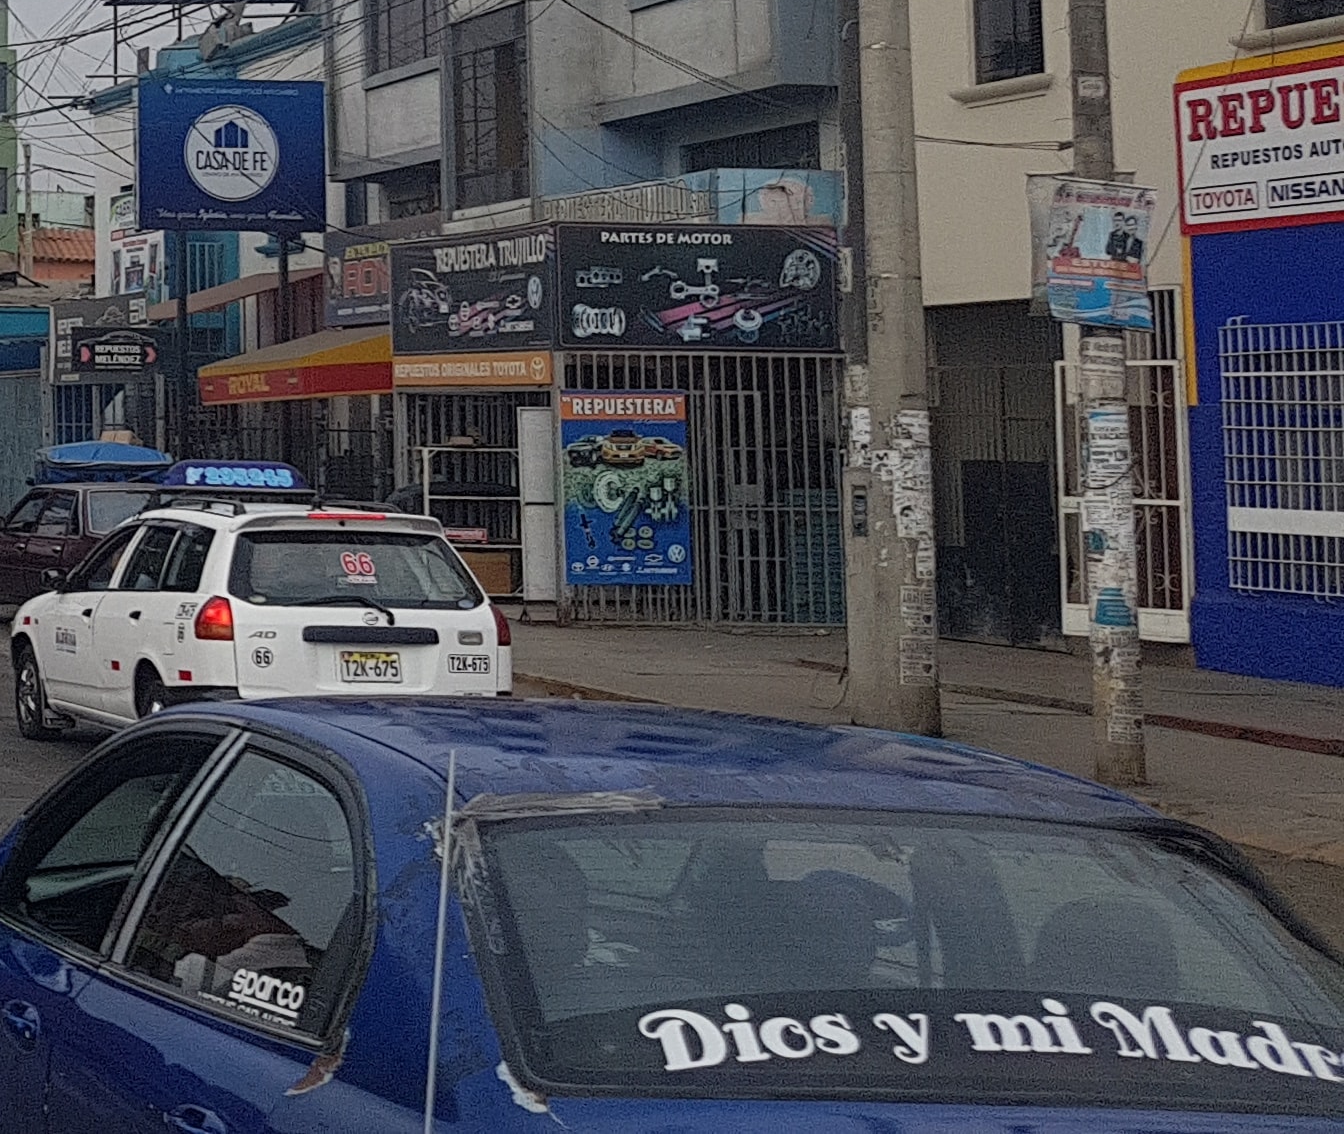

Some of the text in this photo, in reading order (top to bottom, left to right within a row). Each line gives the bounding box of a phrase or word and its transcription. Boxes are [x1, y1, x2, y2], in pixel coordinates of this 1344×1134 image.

[1187, 77, 1344, 142] REPUE
[196, 149, 268, 172] CASA DE FE
[1210, 138, 1344, 170] REPUESTOS AUT
[1193, 188, 1256, 211] TOYOTA
[1270, 177, 1344, 203] NISSAN
[600, 231, 733, 246] PARTES DE MOTOR
[434, 233, 546, 273] REPUESTERA TRUJILLO
[394, 362, 441, 378] REPUESTOS
[492, 361, 527, 376] TOYOTA
[228, 374, 271, 395] ROYAL
[341, 551, 376, 576] 66
[255, 650, 271, 665] 66
[343, 659, 400, 678] T2K-675
[449, 657, 489, 671] T2K-675
[231, 968, 304, 1010] sparco
[638, 1003, 861, 1072] Dios
[872, 1012, 929, 1065] y
[954, 998, 1093, 1056] mi
